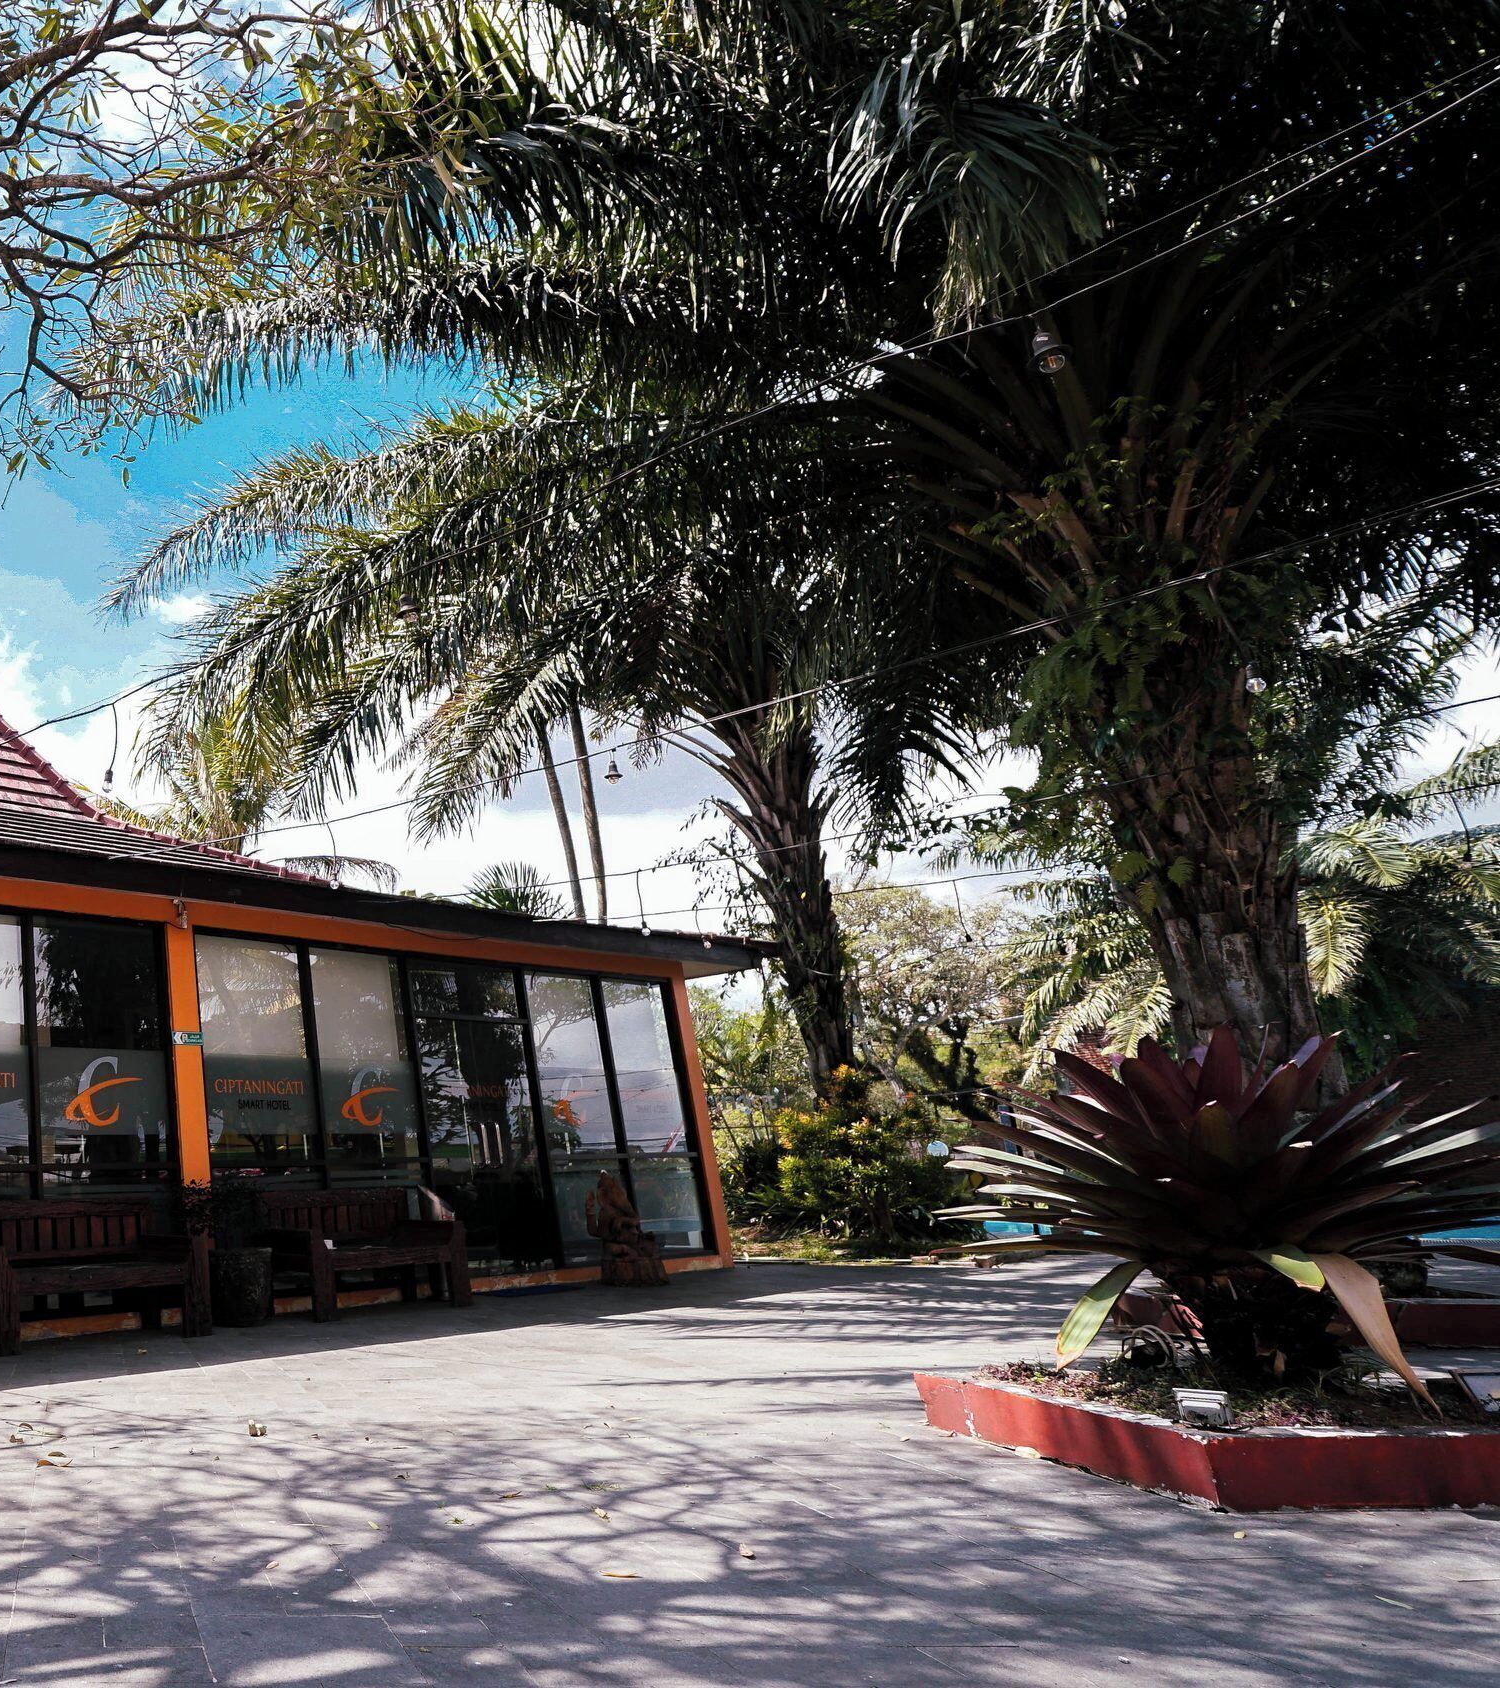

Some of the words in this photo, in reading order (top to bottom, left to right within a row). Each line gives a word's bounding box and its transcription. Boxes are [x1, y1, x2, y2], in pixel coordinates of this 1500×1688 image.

[214, 1079, 304, 1095] CIPTANINGATI
[238, 1099, 263, 1110] SMART
[267, 1099, 291, 1110] HOTEL
